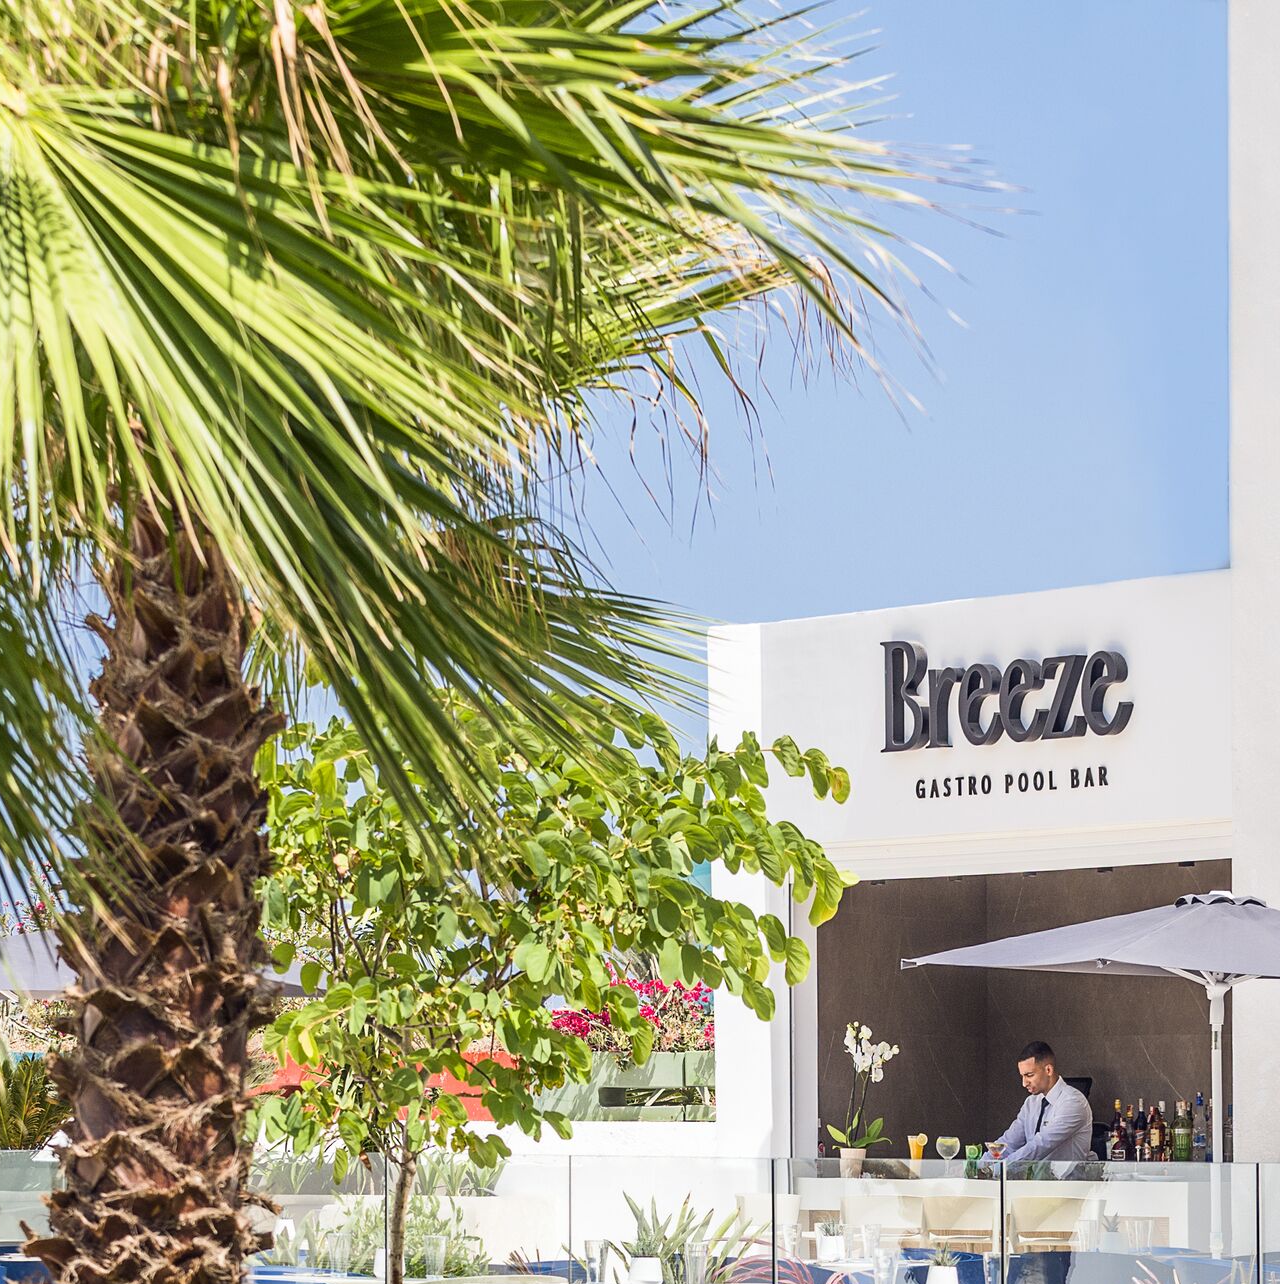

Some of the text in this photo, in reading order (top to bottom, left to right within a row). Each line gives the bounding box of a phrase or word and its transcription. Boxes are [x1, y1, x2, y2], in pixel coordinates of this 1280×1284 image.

[880, 641, 1134, 753] Breeze
[915, 766, 1109, 799] GASTRO POOL BAR
